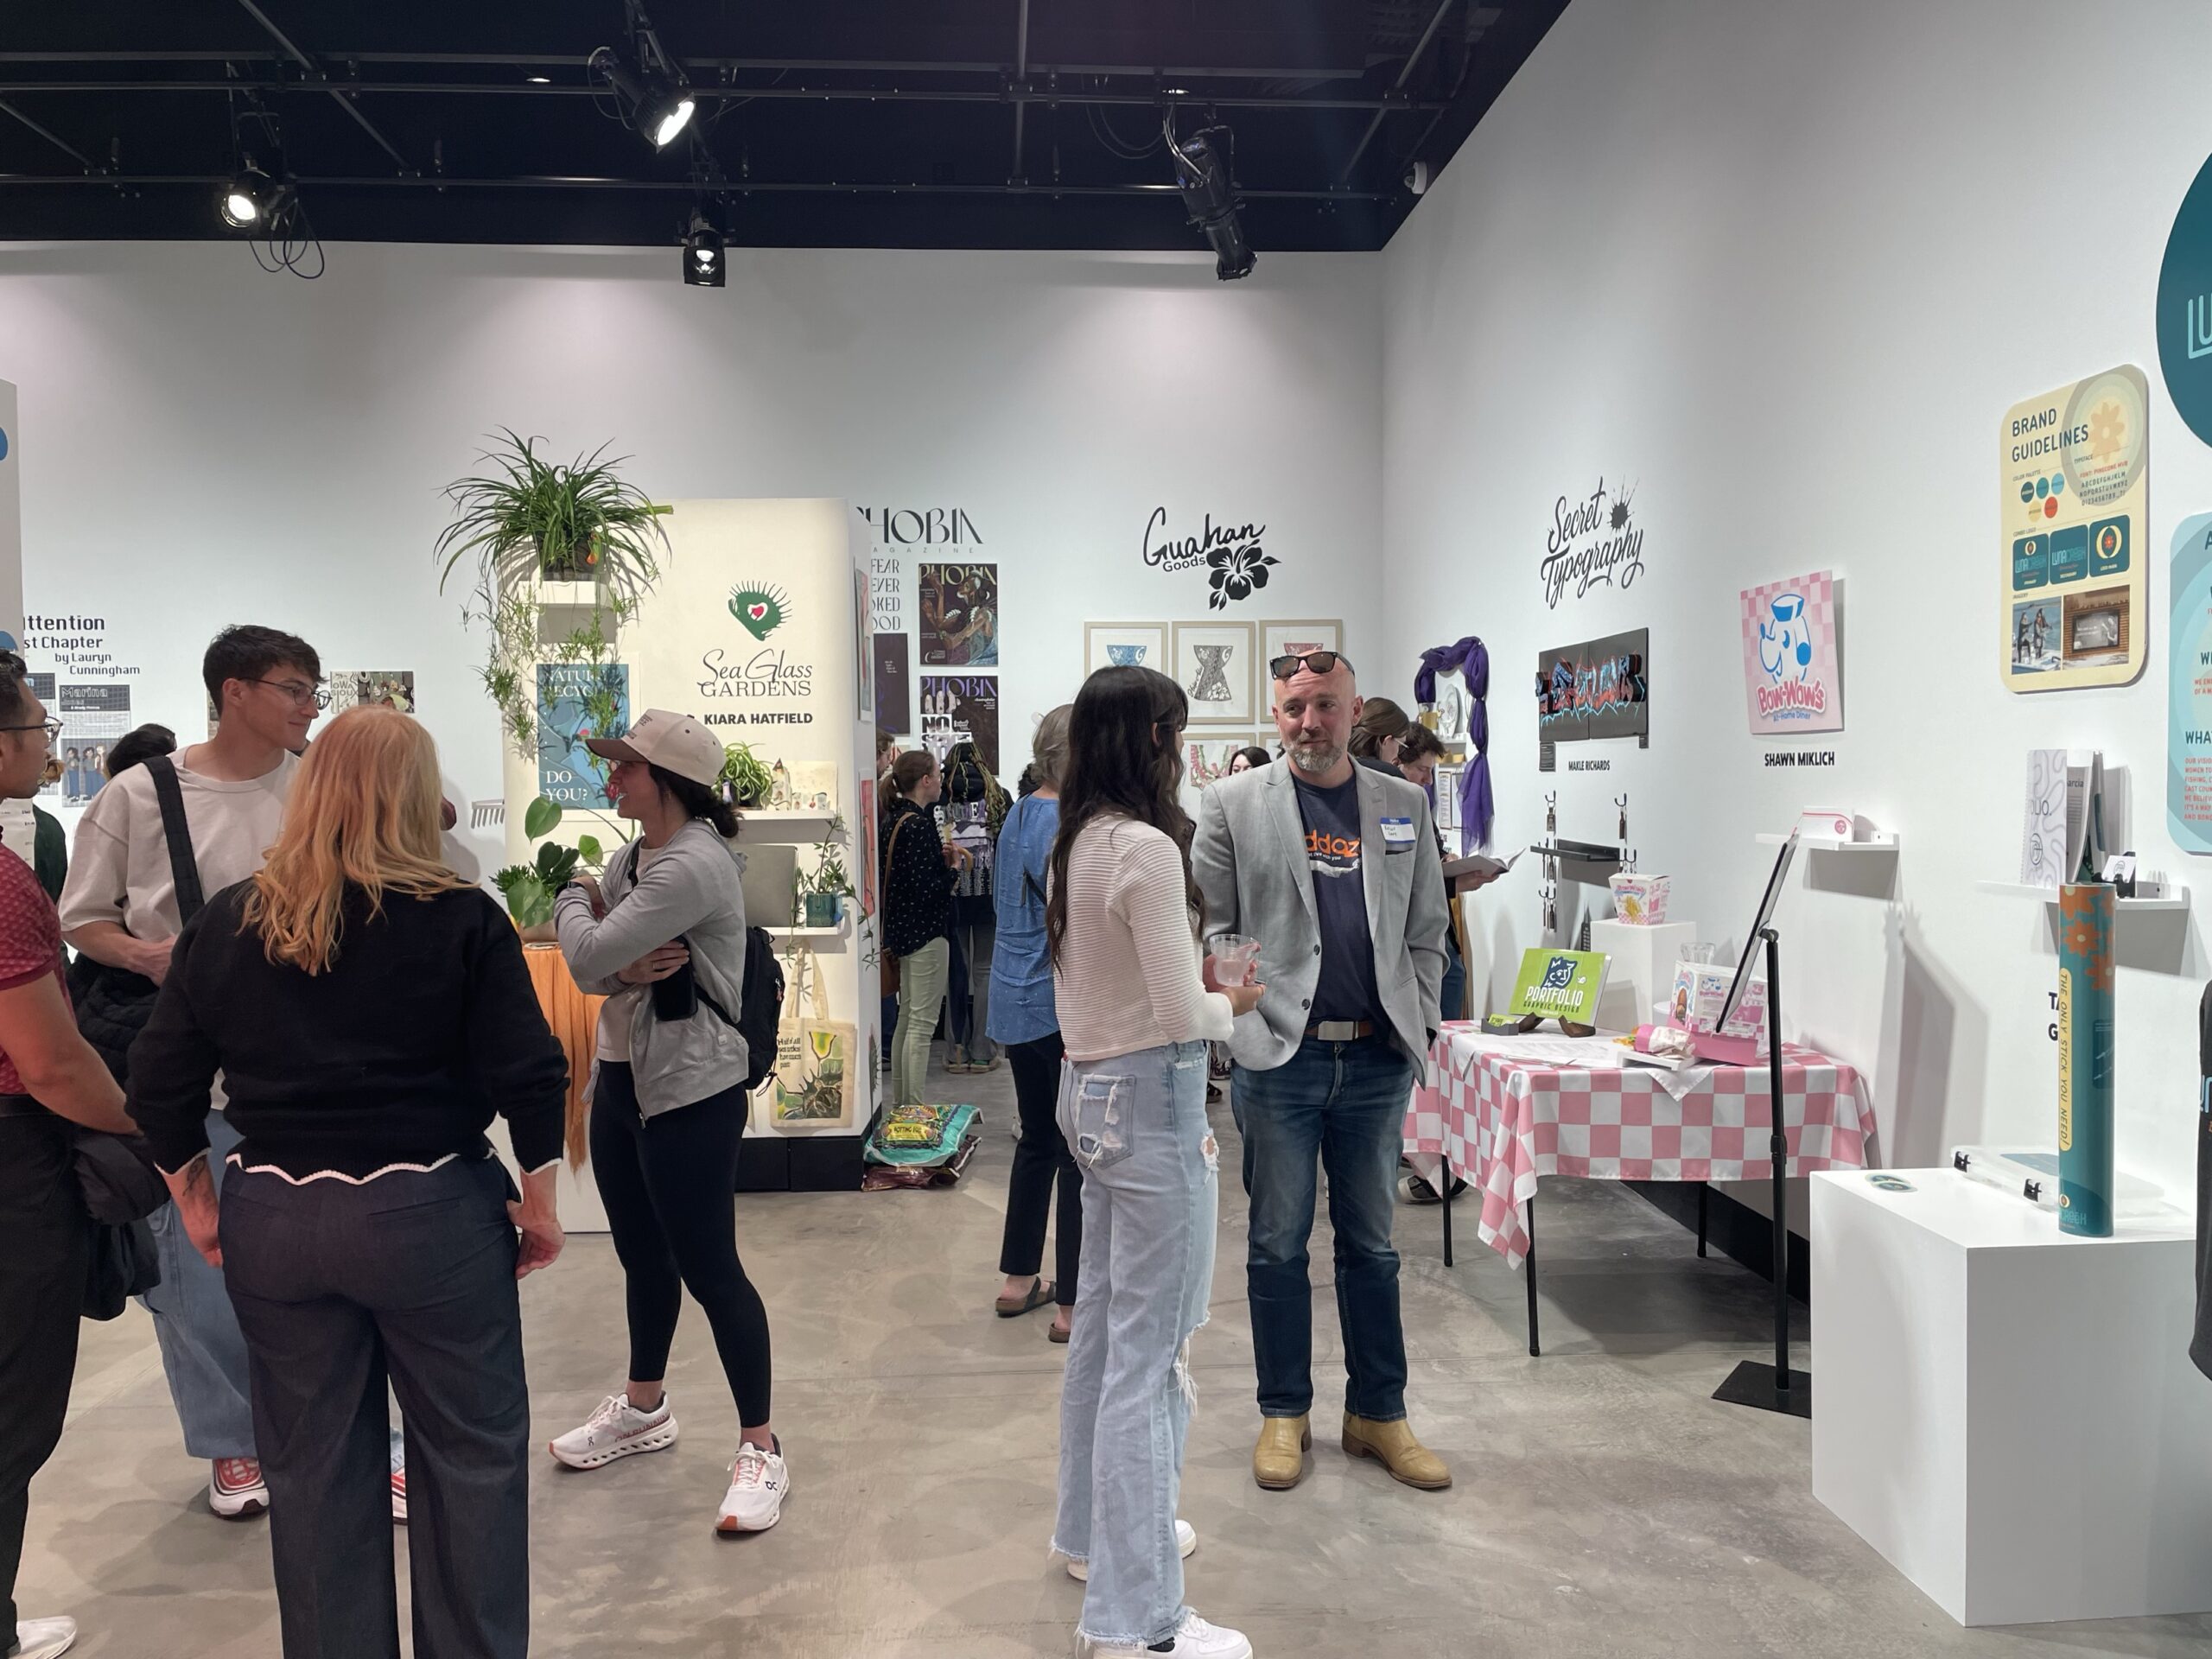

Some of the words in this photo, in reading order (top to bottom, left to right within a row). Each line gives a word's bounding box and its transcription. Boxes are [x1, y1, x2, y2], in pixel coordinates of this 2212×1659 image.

[2012, 408, 2056, 437] BRAND
[2012, 423, 2089, 463] GUIDELINES
[1548, 476, 1606, 554] Secret
[1143, 506, 1266, 567] Guahan
[1163, 556, 1206, 572] Goods
[1541, 520, 1644, 610] Typography
[23, 615, 105, 630] ttention
[41, 636, 103, 650] Chapter
[55, 653, 69, 664] by
[72, 652, 111, 664] Lauryn
[70, 665, 140, 677] Cunningham
[697, 648, 741, 686] Sea
[745, 648, 812, 683] Glass
[61, 687, 108, 698] Marina
[701, 680, 810, 696] GARDENS
[704, 715, 747, 725] KIARA
[750, 713, 813, 724] HATFIELD
[2185, 731, 2212, 744] WHA
[1586, 760, 1611, 771] RICHARDS
[1764, 753, 1796, 766] SHAWN
[1797, 752, 1835, 766] MIKLICH
[546, 770, 572, 784] DO
[545, 788, 588, 801] YOU?
[1525, 987, 1584, 1007] PORTFOLIO
[2061, 1108, 2070, 1146] NEED!
